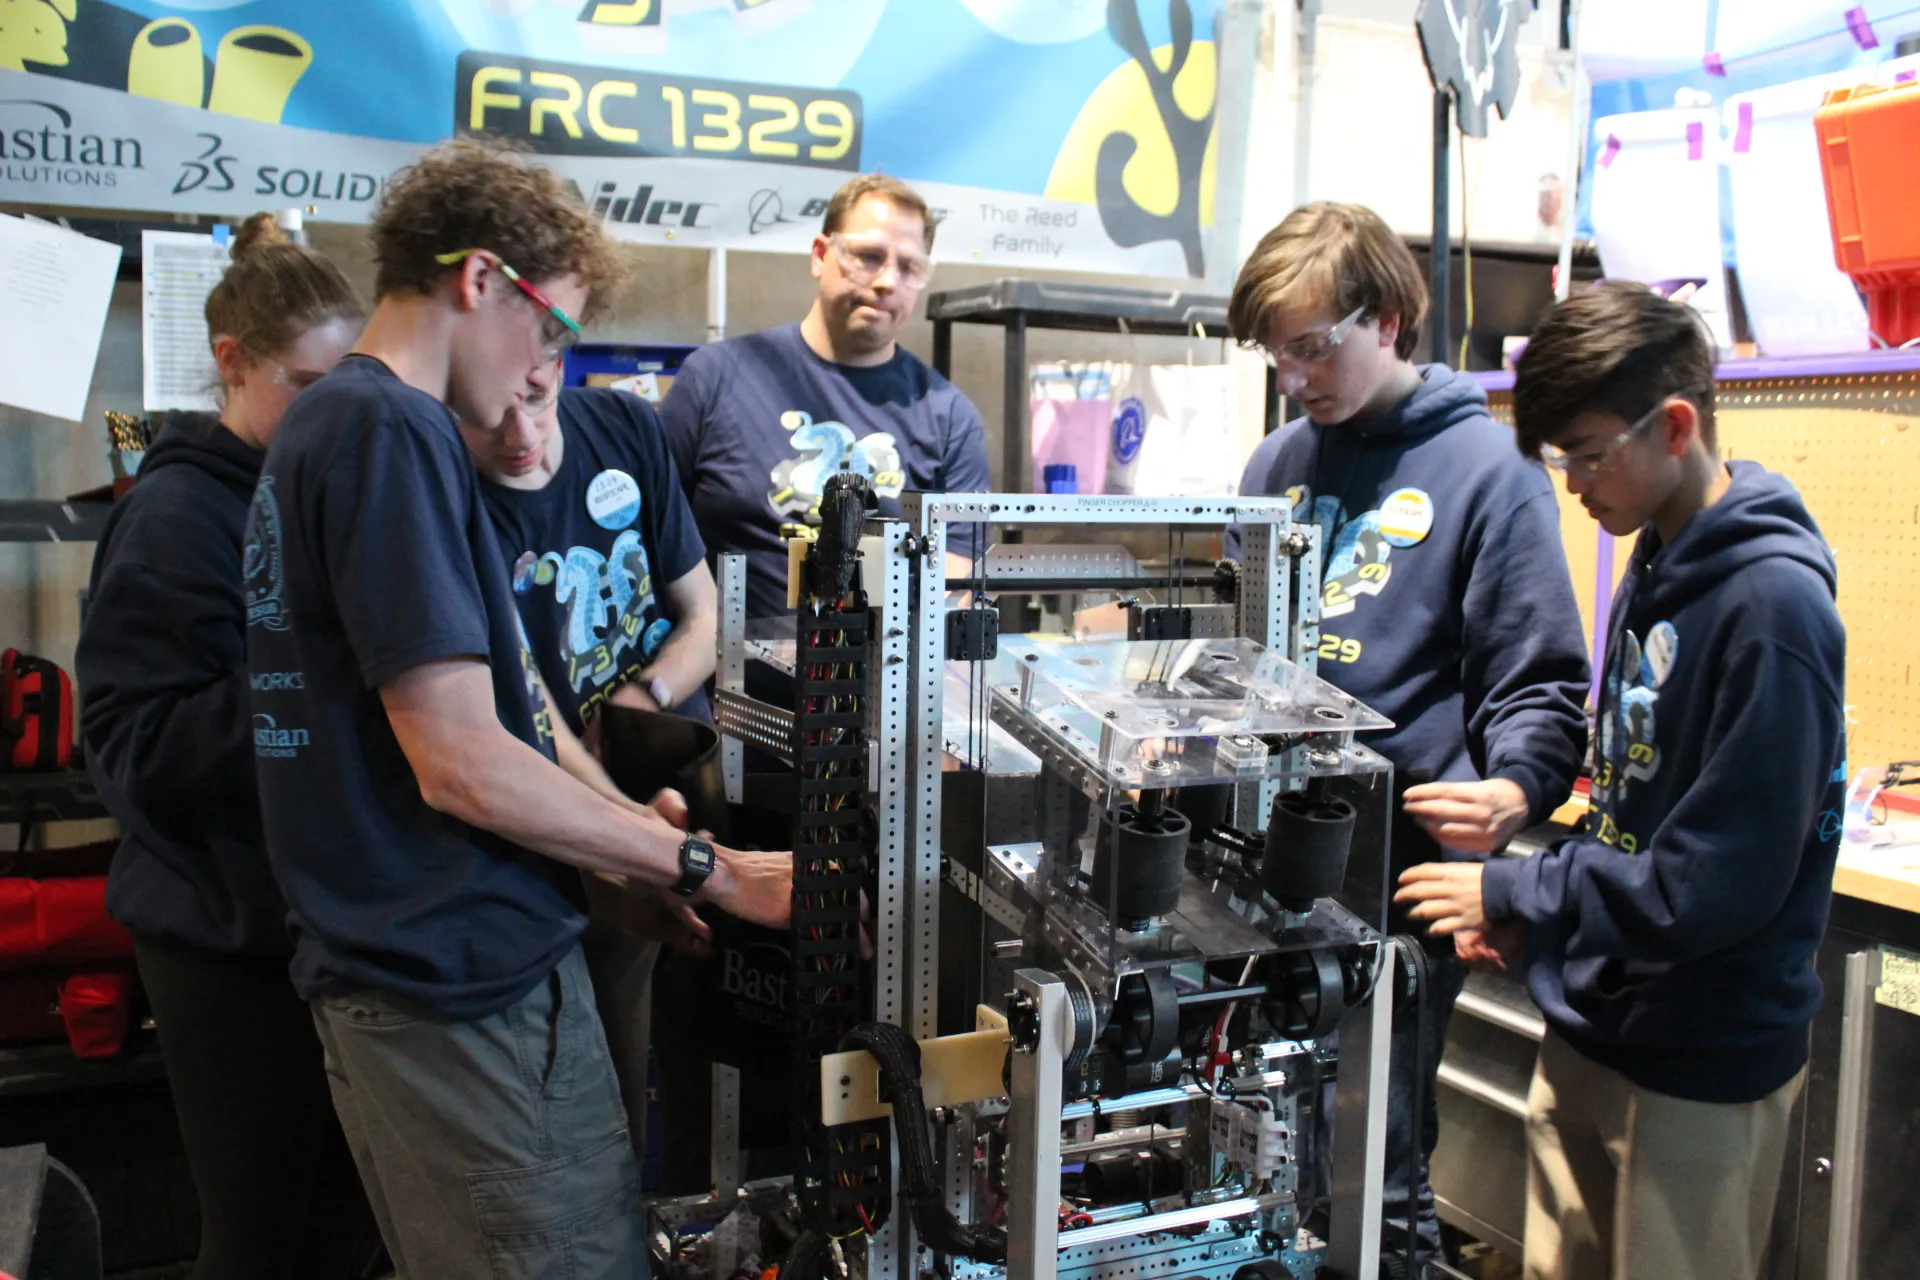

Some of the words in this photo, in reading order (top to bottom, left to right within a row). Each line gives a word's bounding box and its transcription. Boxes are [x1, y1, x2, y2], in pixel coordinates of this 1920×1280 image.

[470, 66, 640, 144] FRC
[661, 86, 854, 160] 1329
[0, 165, 117, 187] LUTIONS
[255, 165, 384, 201] SOLID
[979, 203, 1019, 224] The
[1025, 207, 1078, 228] Reed
[992, 233, 1064, 258] Family
[1078, 498, 1106, 507] FINGER
[1107, 498, 1143, 507] CHOPPER
[1318, 633, 1361, 664] 29
[720, 947, 793, 1012] Bast
